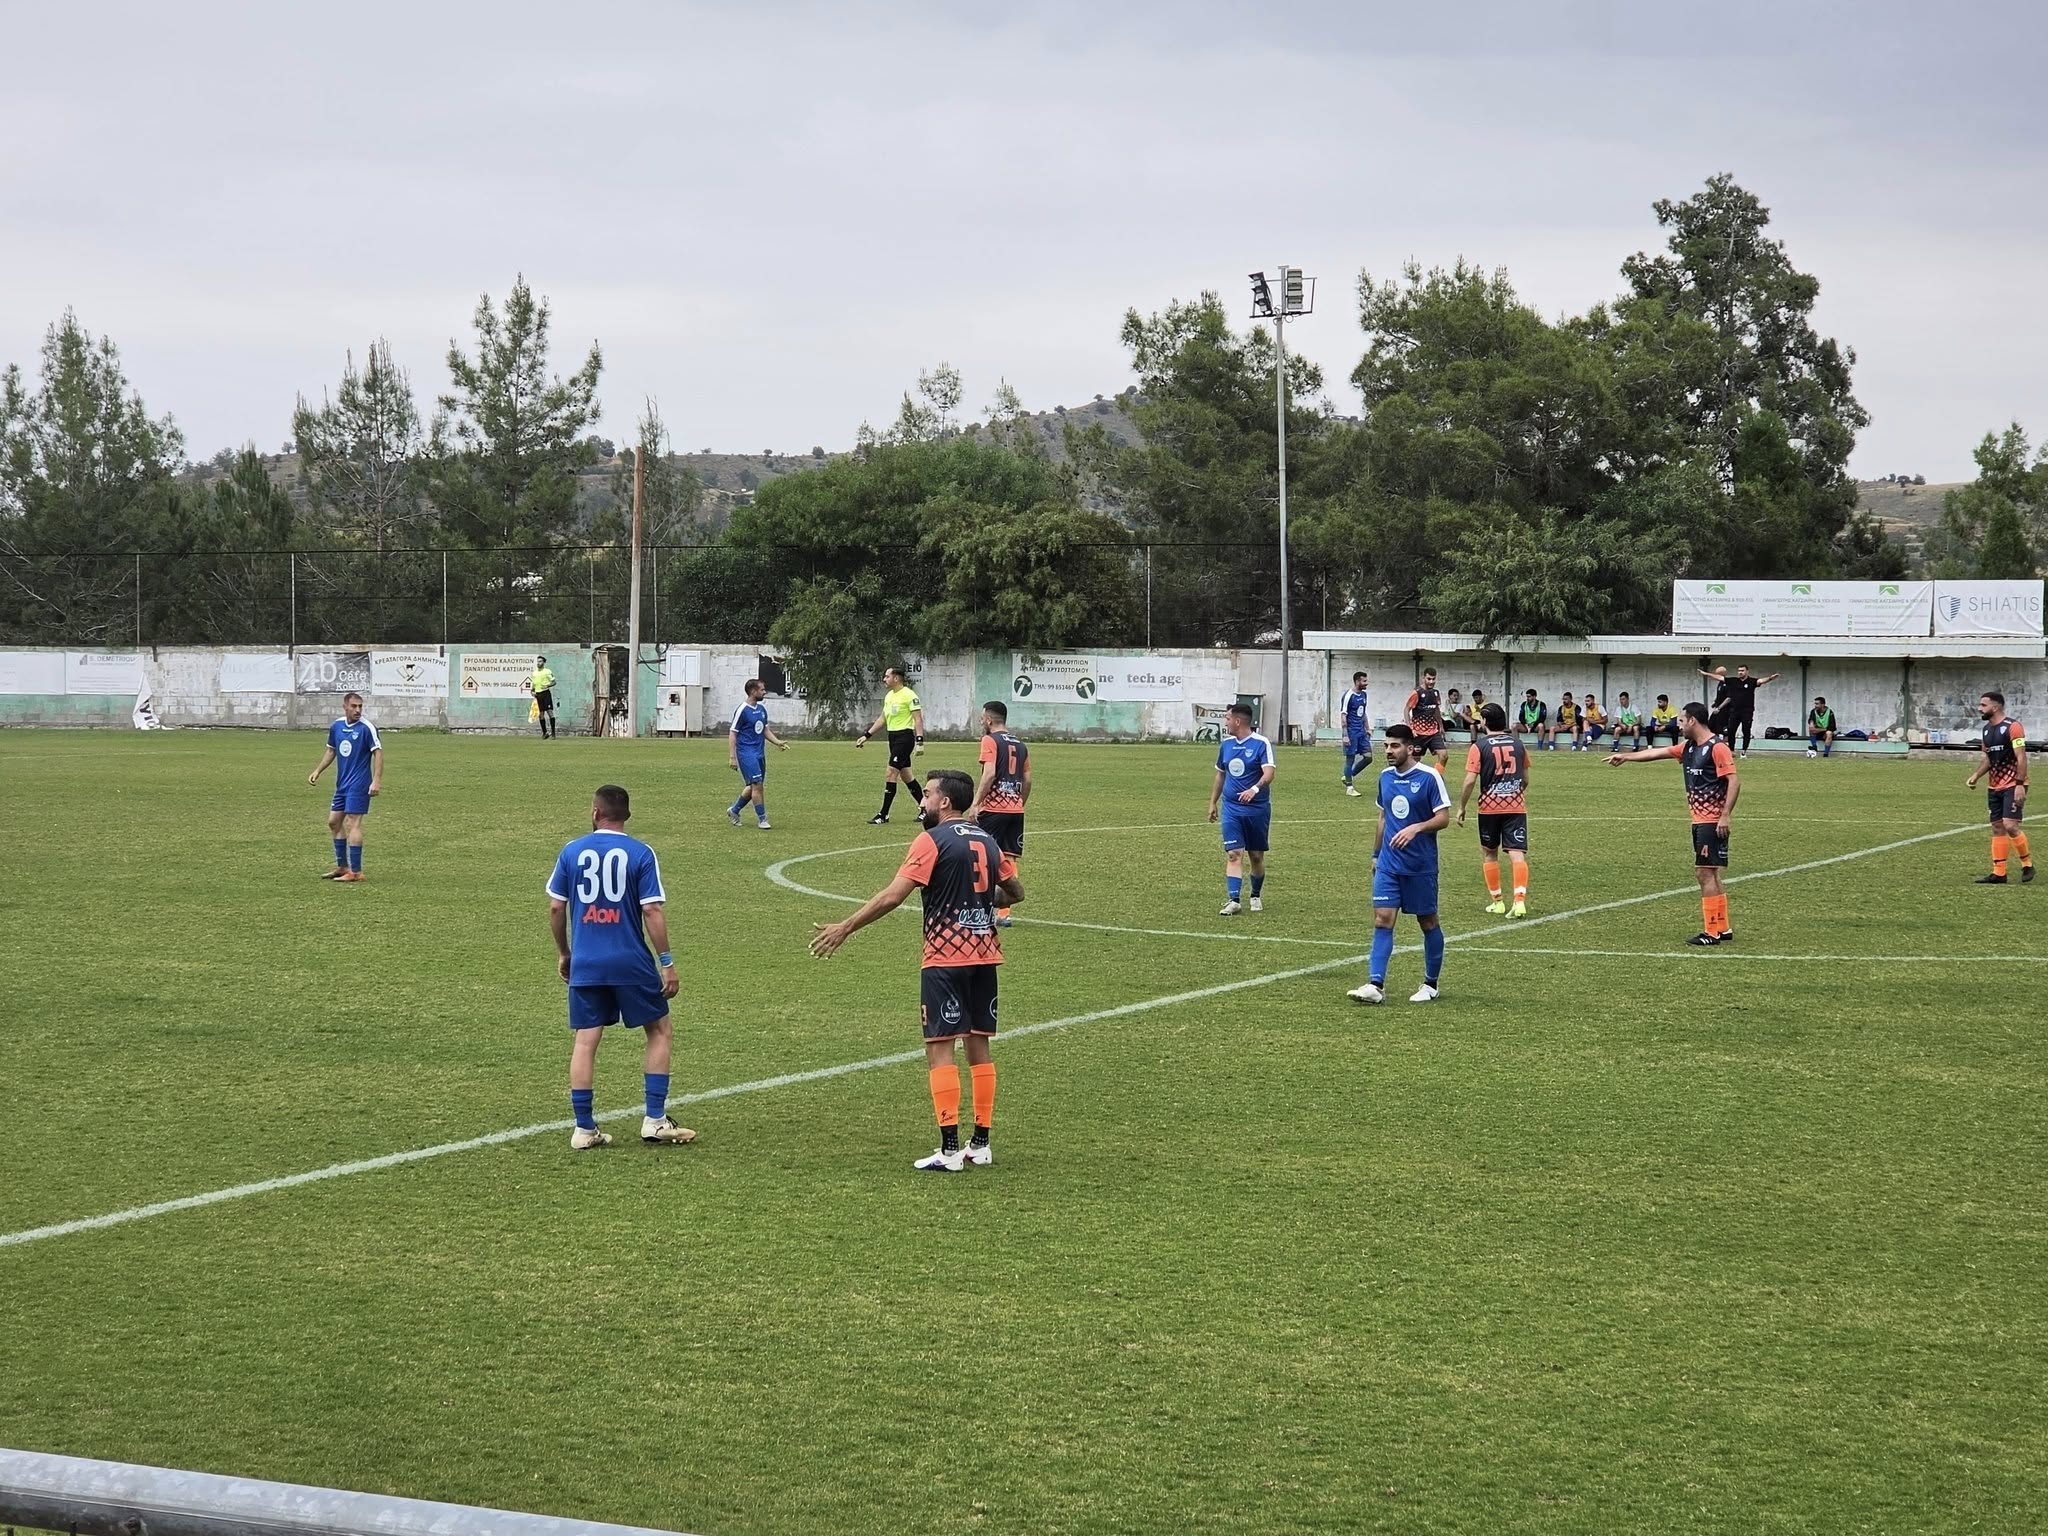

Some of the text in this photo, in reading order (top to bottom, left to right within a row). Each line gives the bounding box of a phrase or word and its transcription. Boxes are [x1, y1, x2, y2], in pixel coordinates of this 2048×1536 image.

[1968, 596, 2040, 612] SHIATIS
[374, 656, 447, 667] ΚΡΕΑΤΑΓΟΡΑ ΔΗΜΗΤΡΗΣ
[1127, 673, 1156, 683] tech
[1008, 744, 1017, 775] 6
[1491, 745, 1516, 775] 15
[1700, 844, 1709, 858] 4
[577, 847, 628, 904] 30
[968, 840, 988, 893] 3
